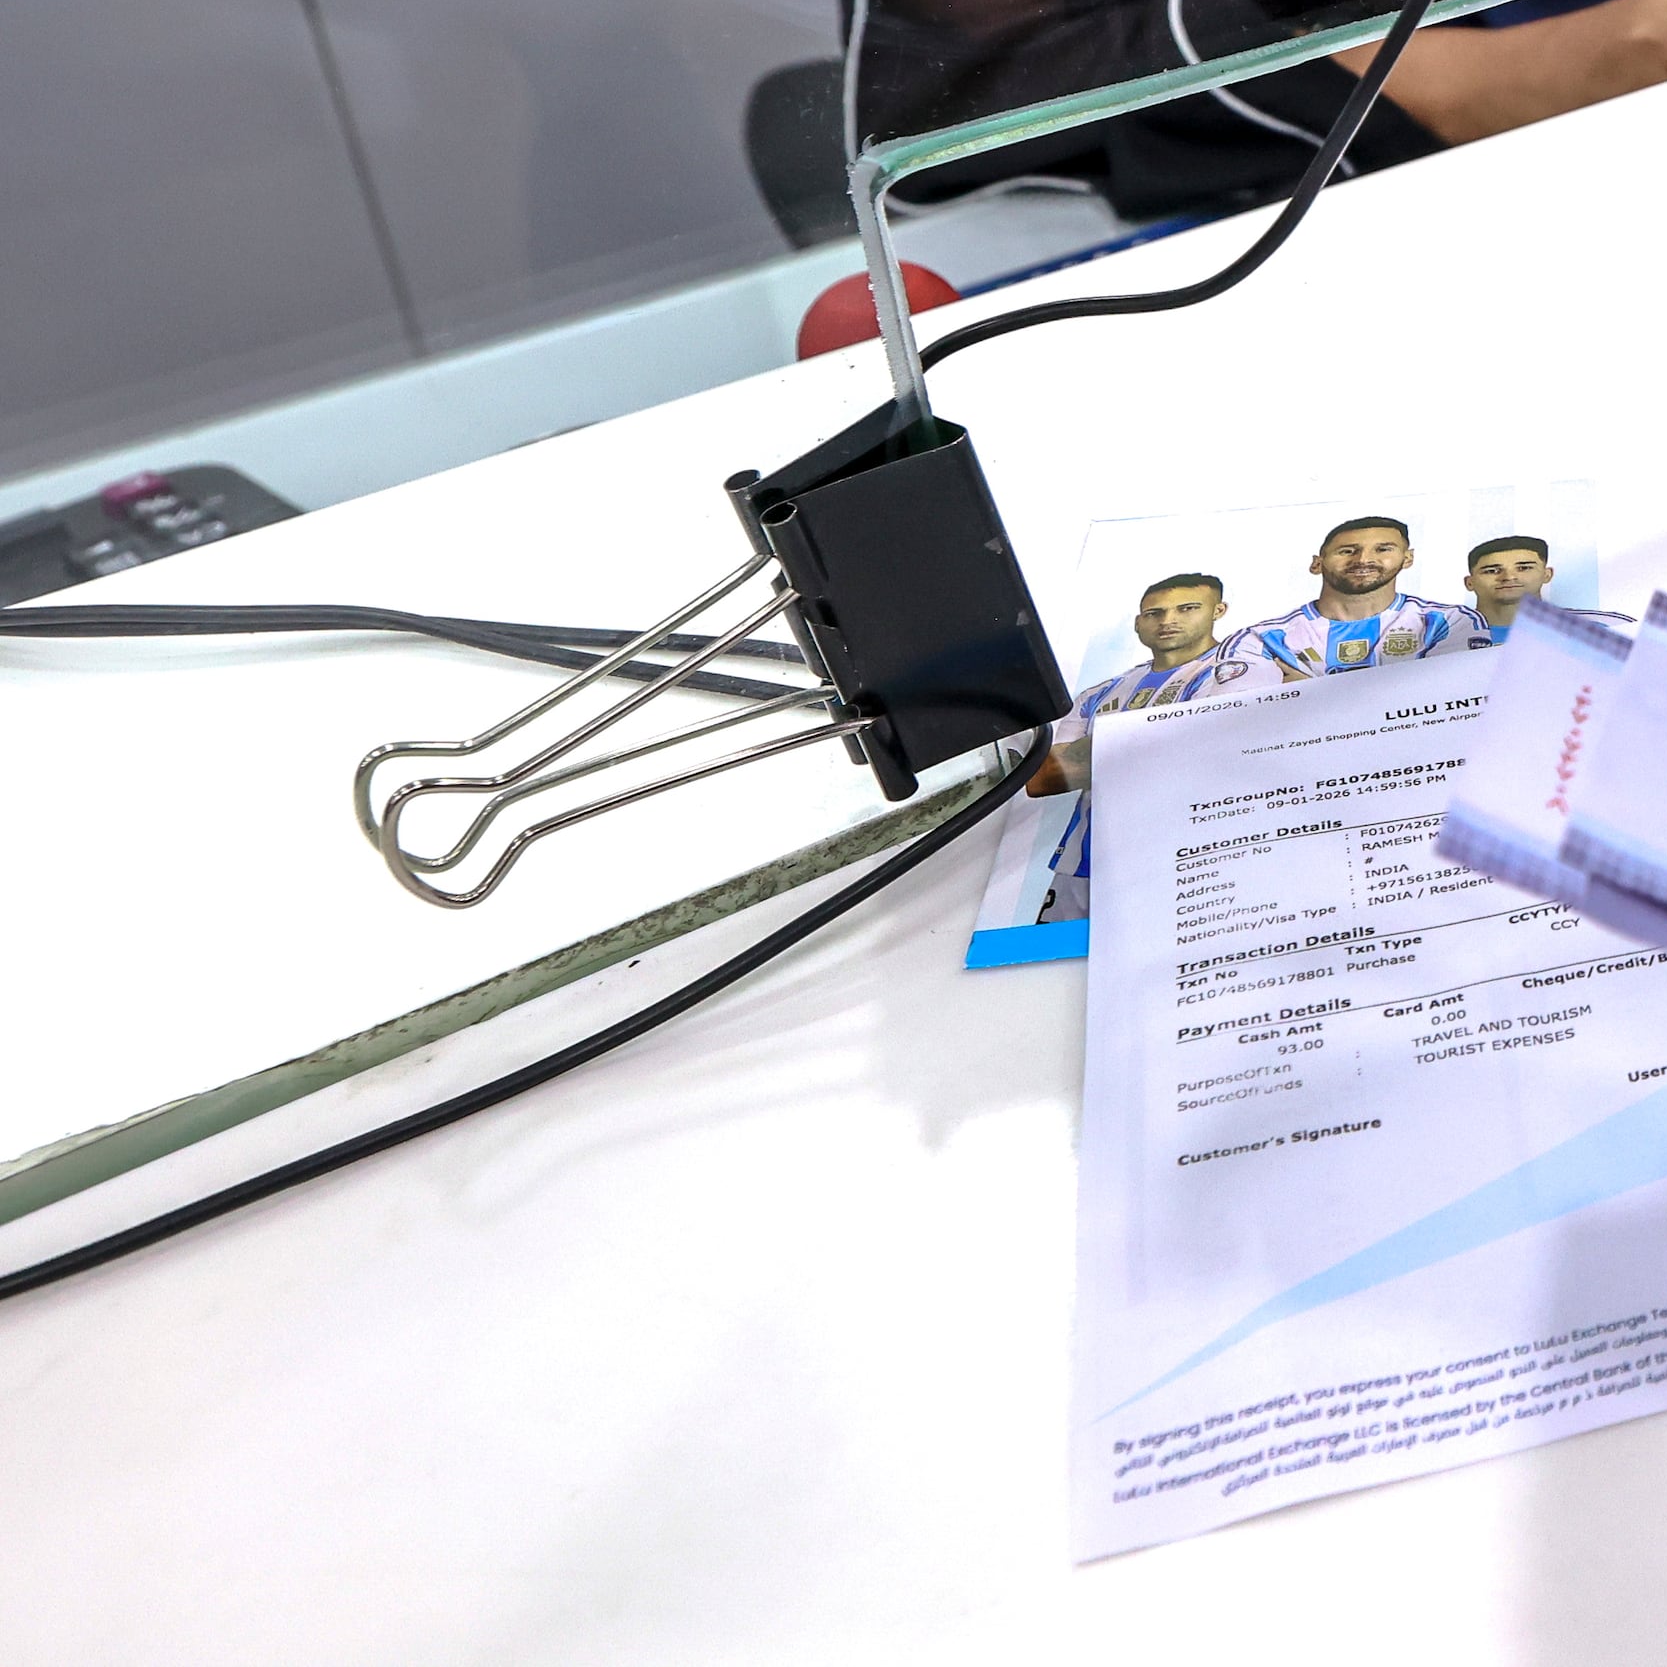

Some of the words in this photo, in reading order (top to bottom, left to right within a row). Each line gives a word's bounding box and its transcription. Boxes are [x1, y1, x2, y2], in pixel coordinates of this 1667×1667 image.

[1256, 690, 1301, 704] 14:59
[1385, 703, 1438, 721] LULU
[1288, 737, 1322, 748] Zayed
[1325, 728, 1376, 743] Shopping
[1380, 722, 1419, 734] Center,
[1422, 717, 1446, 726] New
[1189, 785, 1305, 813] TxnGroupNo:
[1189, 806, 1255, 825] TxnDate:
[1267, 789, 1351, 809] 09-01-2026
[1357, 777, 1422, 795] 14:59:56
[1427, 773, 1446, 784] PM
[1176, 831, 1269, 858] Customer
[1277, 819, 1343, 837] Details
[1176, 852, 1248, 872] Customer
[1253, 844, 1272, 855] No
[1176, 869, 1220, 886] Name
[1361, 833, 1423, 852] RAMESH
[1175, 881, 1236, 901] Address
[1176, 895, 1236, 916] Country
[1364, 863, 1409, 879] INDIA
[1176, 913, 1296, 946] Nationality/Visa
[1301, 904, 1337, 920] Type
[1367, 890, 1413, 907] INDIA
[1429, 875, 1494, 896] Resident
[1176, 900, 1279, 931] Mobile/Phone
[1176, 940, 1299, 975] Transaction
[1305, 925, 1376, 947] Details
[1177, 975, 1209, 991] Txn
[1215, 968, 1238, 980] No
[1344, 942, 1376, 956] Txn
[1381, 936, 1423, 951] Type
[1346, 952, 1416, 973] Purchase
[1551, 917, 1580, 931] CCY
[1177, 1012, 1272, 1041] Payment
[1279, 997, 1352, 1020] Details
[1238, 1025, 1281, 1045] Cash
[1286, 1021, 1324, 1036] Amt
[1383, 1002, 1424, 1018] Card
[1428, 993, 1465, 1009] Amt
[1277, 1039, 1324, 1056] 93.00
[1431, 1009, 1467, 1026] 0.00
[1411, 1027, 1474, 1049] TRAVEL
[1477, 1017, 1513, 1034] AND
[1516, 1003, 1593, 1028] TOURISM
[1413, 1043, 1487, 1066] TOURIST
[1491, 1027, 1576, 1052] EXPENSES
[1177, 1136, 1286, 1167] Customer's
[1291, 1117, 1382, 1144] Signature
[1113, 1439, 1134, 1455] By
[1138, 1423, 1202, 1449] signing
[1204, 1411, 1234, 1431] this
[1238, 1392, 1301, 1420] receipt,
[1303, 1386, 1335, 1405] you
[1338, 1374, 1402, 1396] express
[1405, 1365, 1442, 1385] your
[1445, 1348, 1510, 1374] consent
[1514, 1343, 1530, 1357] to
[1571, 1313, 1648, 1342] Exchange
[1155, 1450, 1265, 1493] International
[1267, 1432, 1350, 1462] Exchange
[1353, 1424, 1382, 1440] LLC
[1385, 1420, 1399, 1433] is
[1402, 1404, 1472, 1429] licensed
[1475, 1398, 1496, 1415] by
[1500, 1389, 1527, 1407] the
[1530, 1371, 1590, 1398] Central
[1593, 1362, 1632, 1382] Bank
[1635, 1356, 1652, 1370] of
